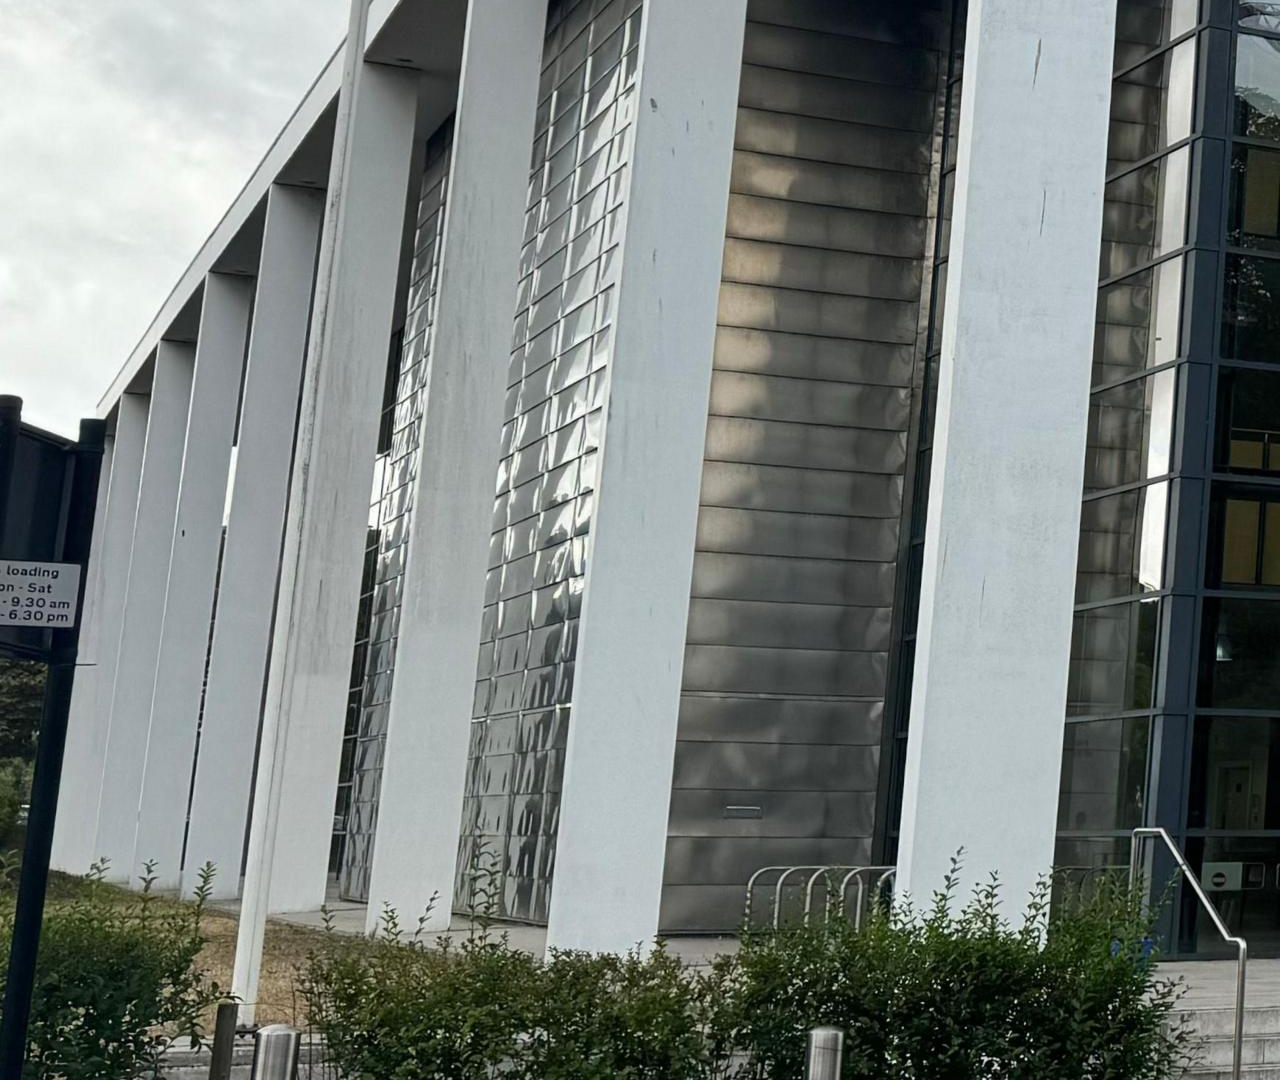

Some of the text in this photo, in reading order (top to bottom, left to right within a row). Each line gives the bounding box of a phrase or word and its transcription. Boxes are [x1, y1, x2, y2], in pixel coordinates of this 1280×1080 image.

[7, 565, 59, 579] loading
[0, 584, 14, 592] on
[27, 582, 52, 593] Sat
[11, 596, 46, 608] 9.30
[49, 601, 70, 609] am
[8, 609, 44, 621] 6.30
[46, 613, 68, 623] pm
